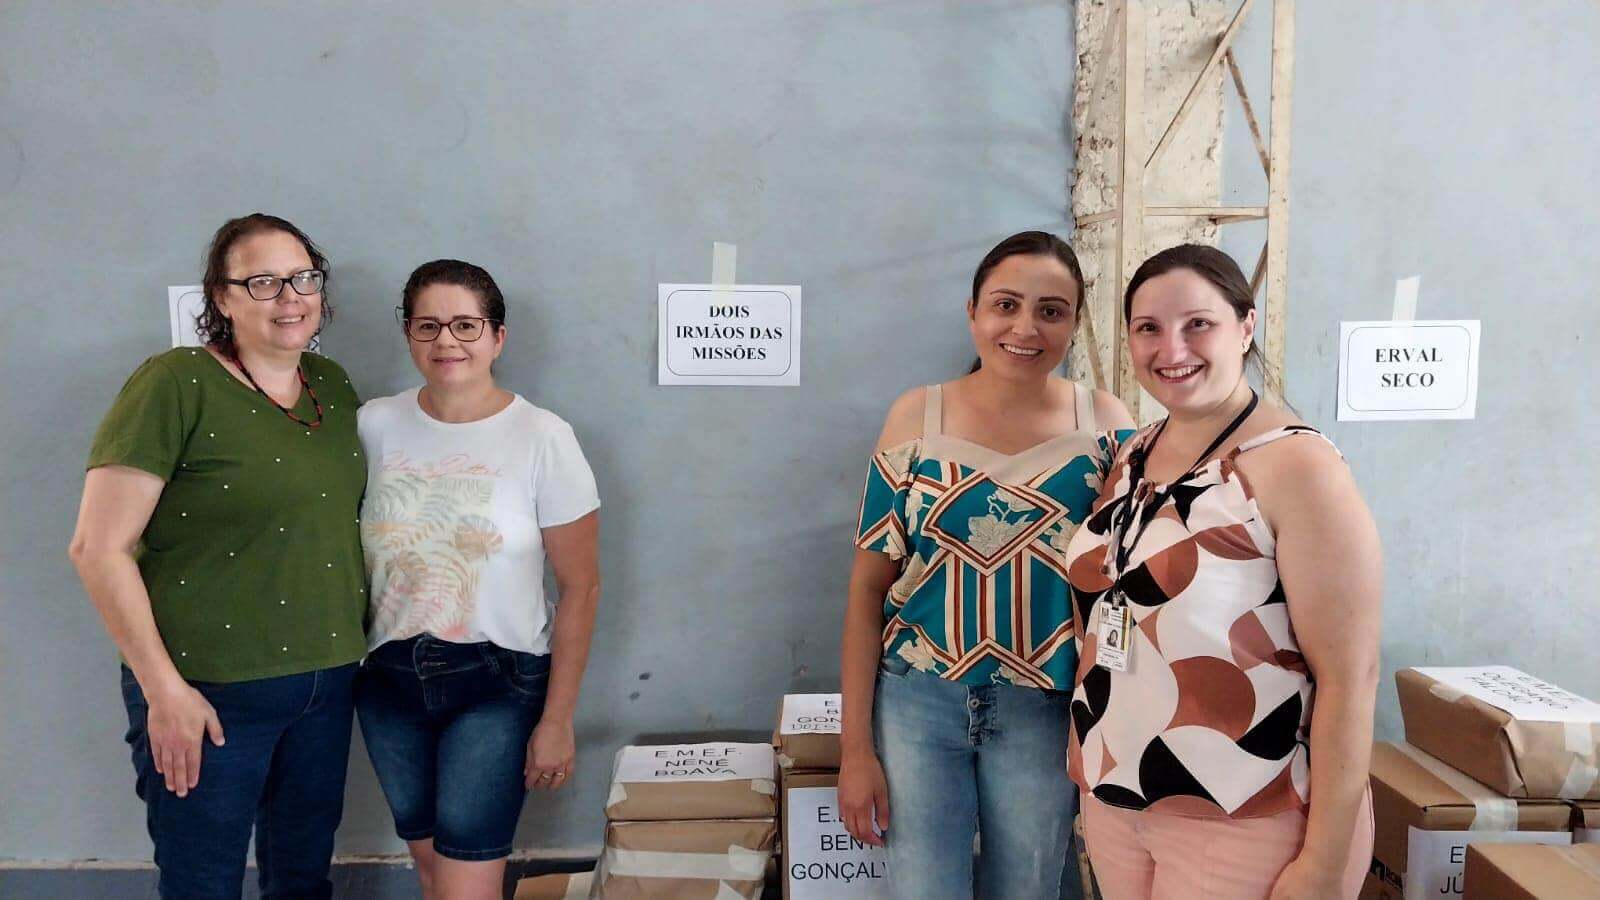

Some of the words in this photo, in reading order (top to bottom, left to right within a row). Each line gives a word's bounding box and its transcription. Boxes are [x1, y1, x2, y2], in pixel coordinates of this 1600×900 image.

[709, 305, 750, 318] DOIS
[676, 323, 745, 339] IRMÃOS
[750, 327, 783, 339] DAS
[692, 344, 766, 360] MISSÕES
[1375, 348, 1443, 363] ERVAL
[1381, 373, 1434, 388] SECO
[820, 834, 873, 851] BEN
